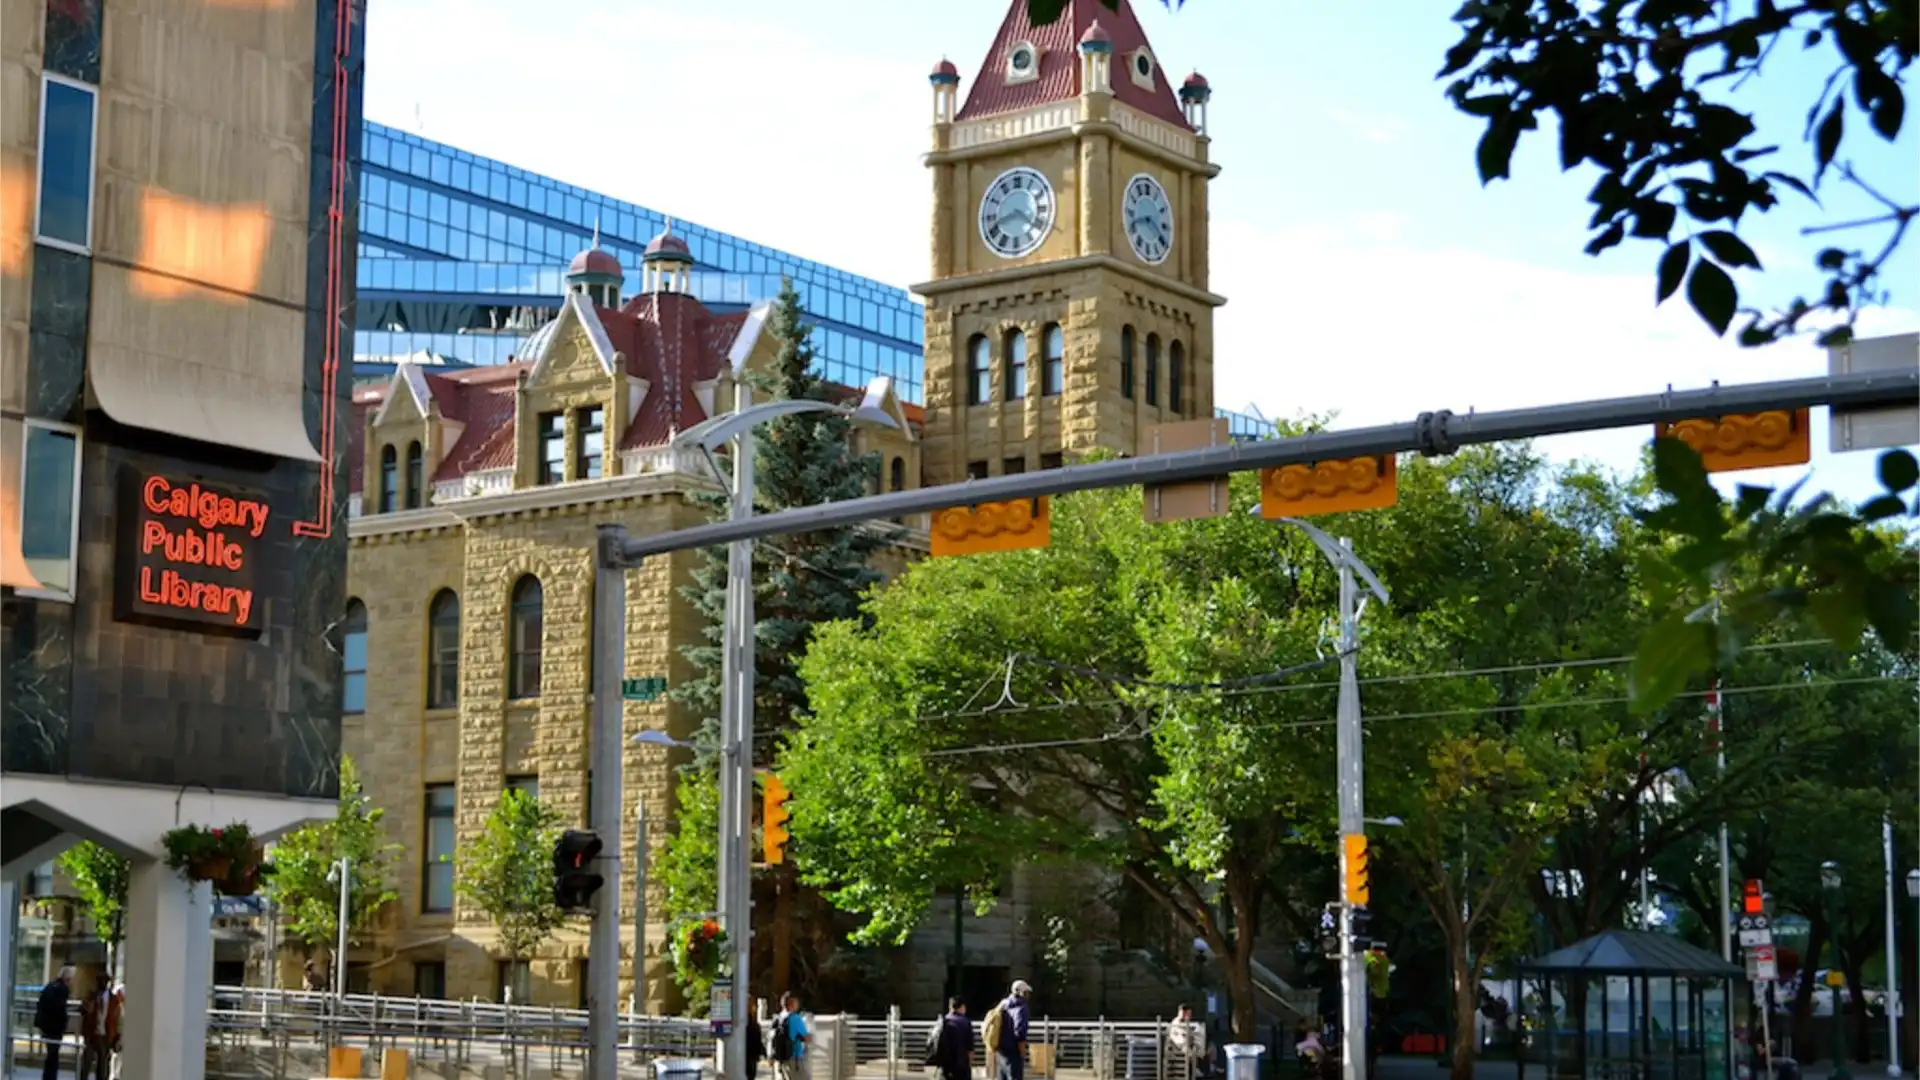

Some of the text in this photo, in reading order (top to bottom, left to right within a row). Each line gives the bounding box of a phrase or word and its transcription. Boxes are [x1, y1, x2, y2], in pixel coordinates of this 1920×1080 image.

[144, 475, 269, 537] Calgary
[143, 520, 243, 570] Public
[141, 567, 252, 624] Library
